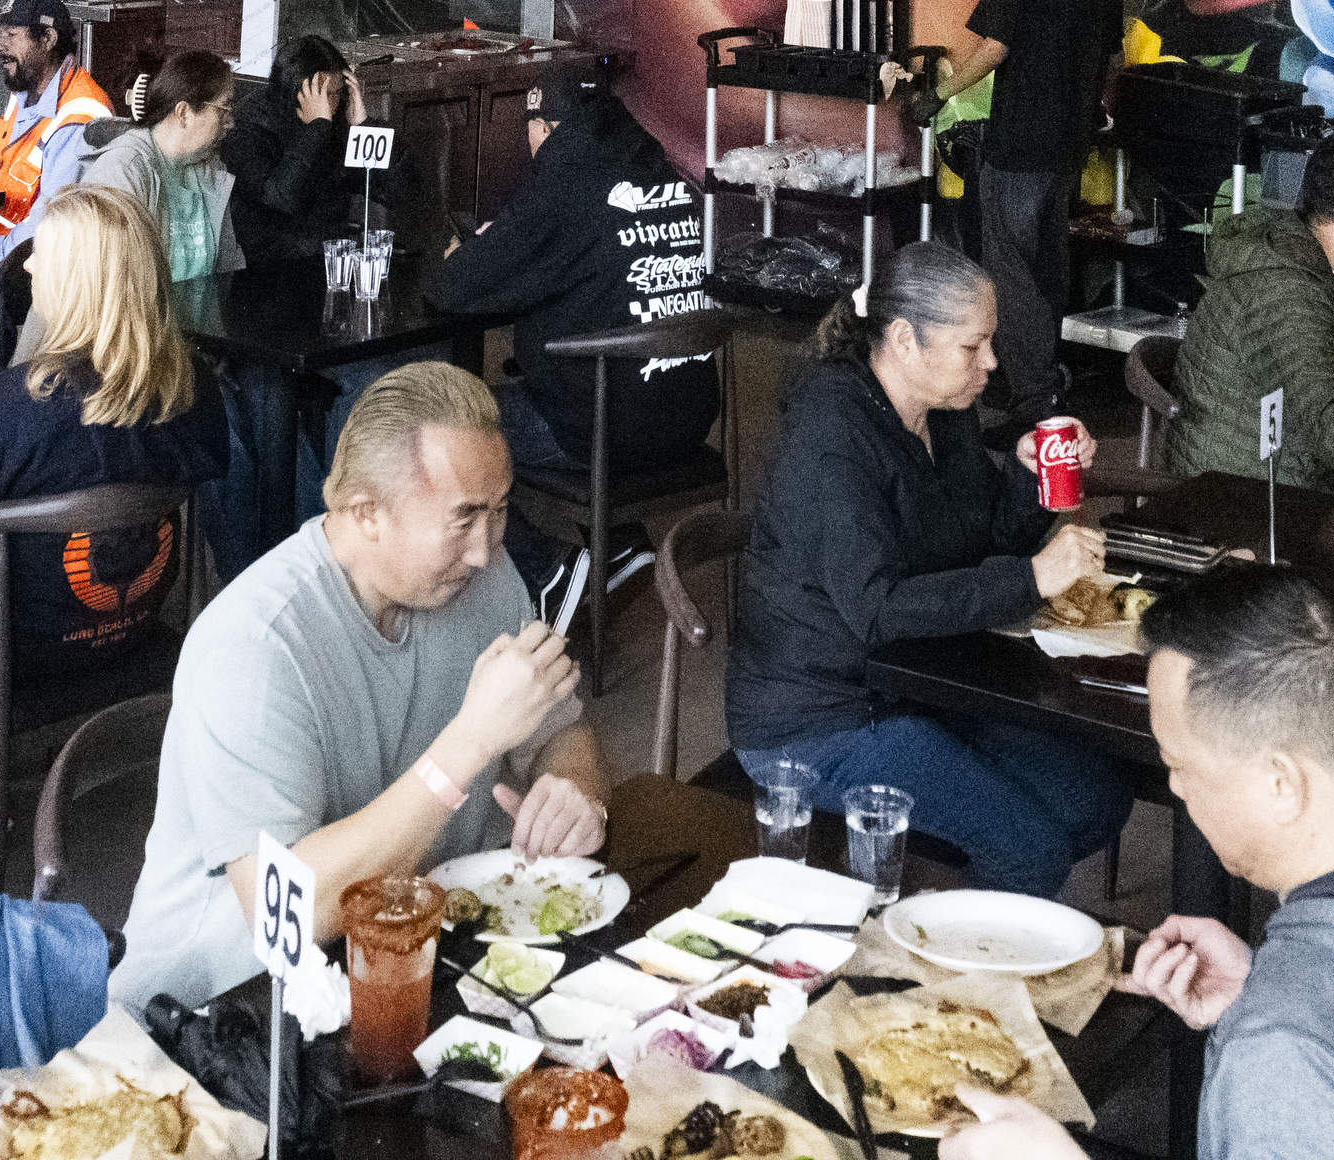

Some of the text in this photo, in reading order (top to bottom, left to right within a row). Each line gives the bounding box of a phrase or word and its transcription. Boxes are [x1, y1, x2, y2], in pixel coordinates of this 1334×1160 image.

[351, 133, 388, 162] 100
[1268, 402, 1277, 446] 5
[264, 862, 304, 968] 95
